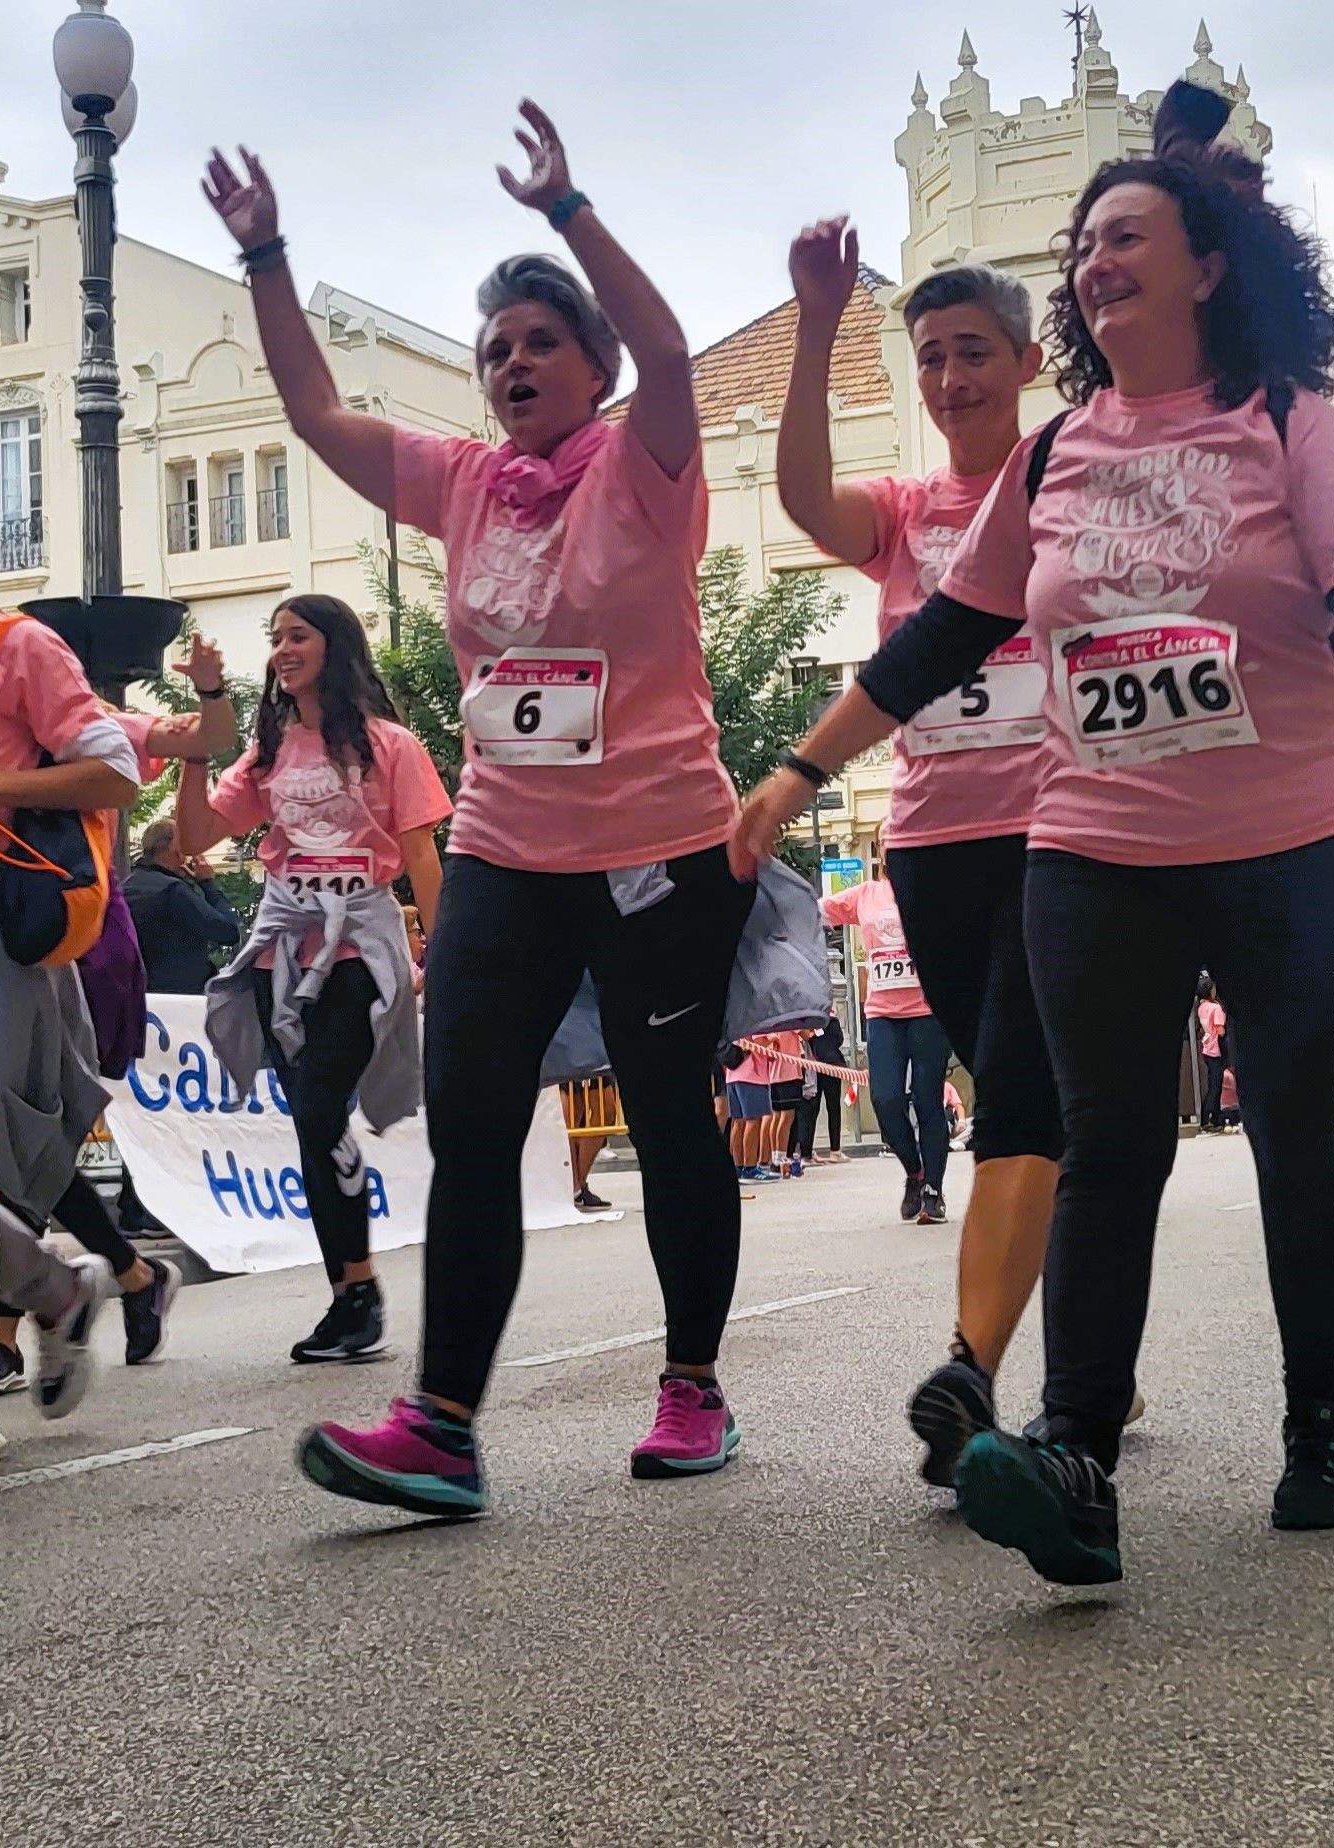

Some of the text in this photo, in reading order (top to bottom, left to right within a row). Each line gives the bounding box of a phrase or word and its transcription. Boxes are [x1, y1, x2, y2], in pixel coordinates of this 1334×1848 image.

[513, 691, 542, 734] 6
[960, 672, 989, 717] 5
[1077, 659, 1231, 733] 2916
[874, 961, 916, 979] 1791
[202, 1149, 391, 1220] Huea
